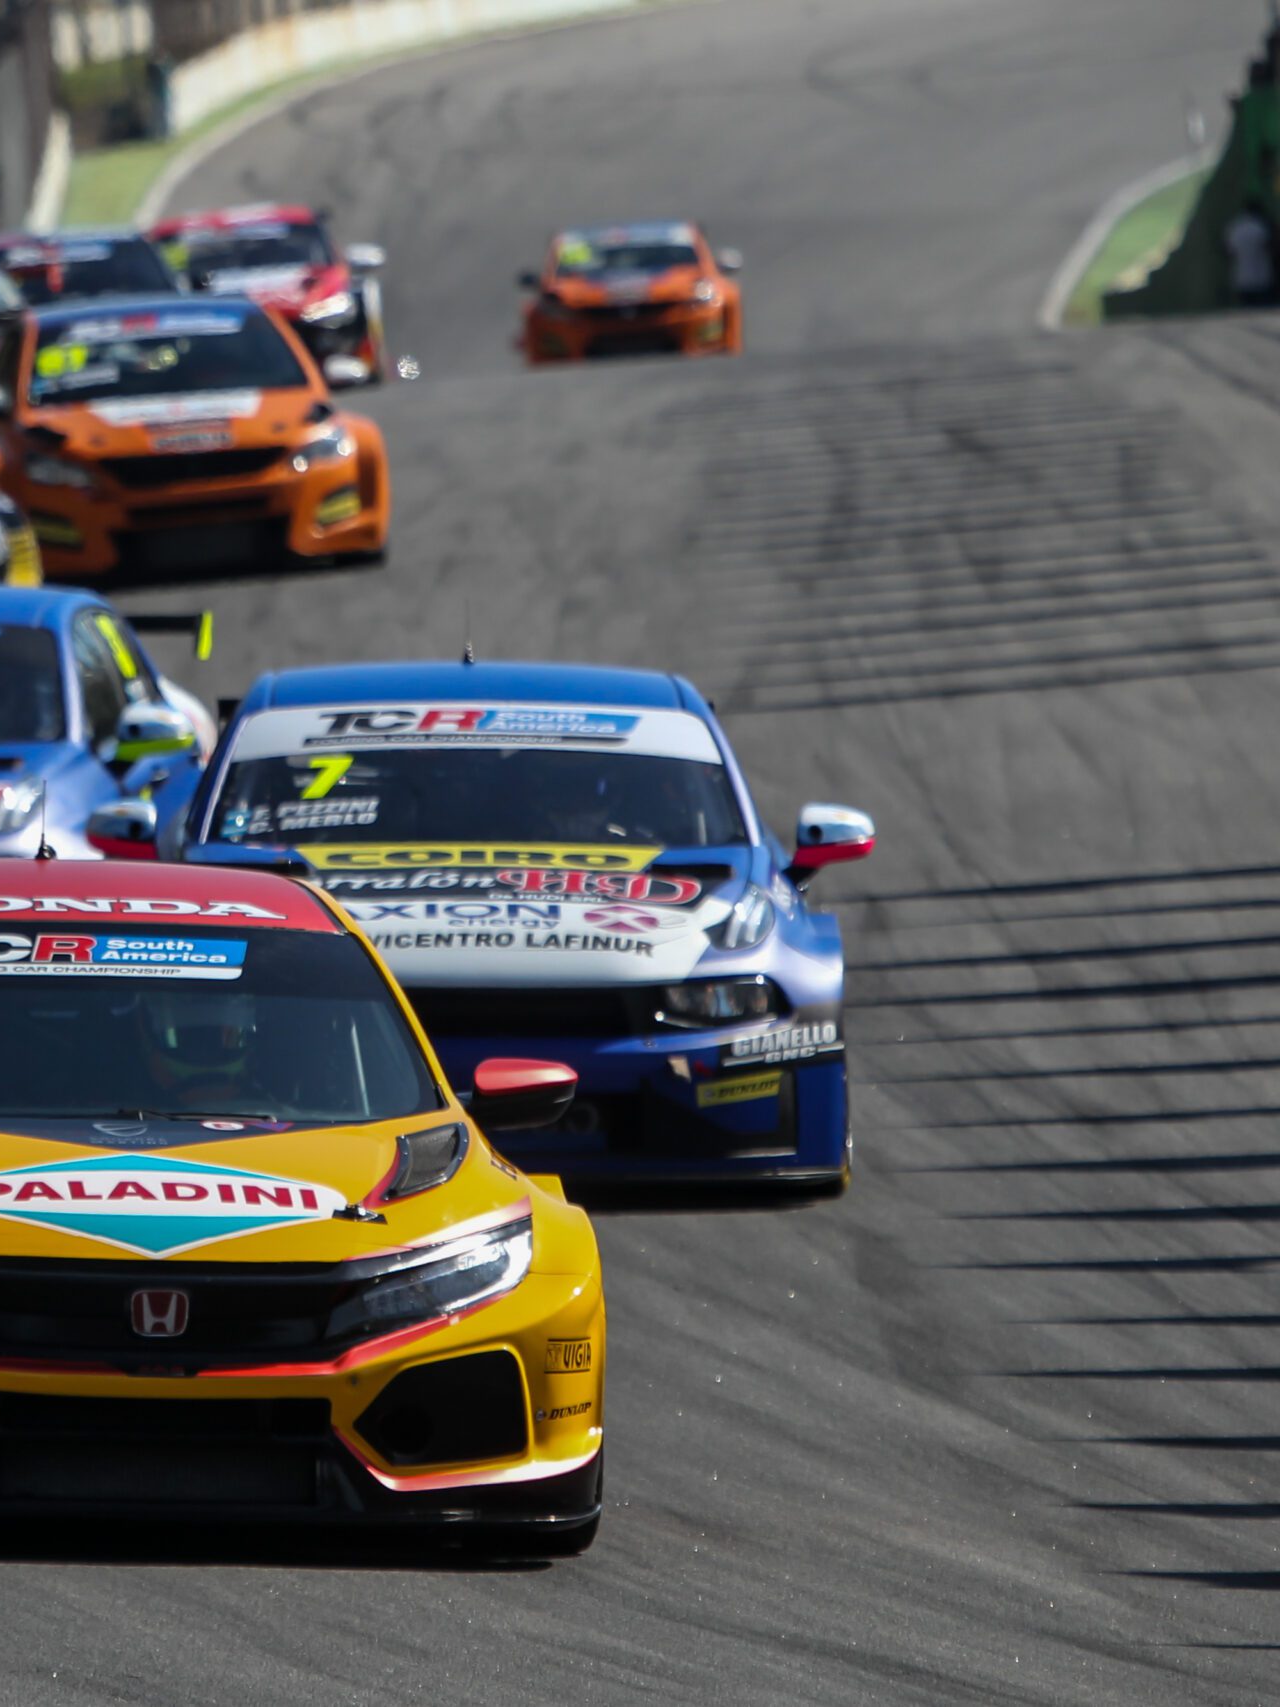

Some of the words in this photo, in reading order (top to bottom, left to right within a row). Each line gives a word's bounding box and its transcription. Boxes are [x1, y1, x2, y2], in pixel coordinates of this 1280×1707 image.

[319, 710, 484, 735] TCR
[496, 712, 586, 722] South
[485, 722, 617, 734] America
[301, 754, 354, 799] 7
[276, 800, 379, 818] PEZZINI
[280, 813, 377, 831] MERLO
[325, 850, 632, 867] COIRO
[448, 919, 560, 930] energy
[106, 939, 194, 951] South
[526, 933, 654, 957] LAFINUR
[101, 951, 227, 964] America
[13, 966, 48, 974] CAR
[52, 967, 181, 976] CHAMPIONSHIP
[731, 1023, 837, 1057] GIANELLO
[549, 1402, 592, 1420] DUNLOP
